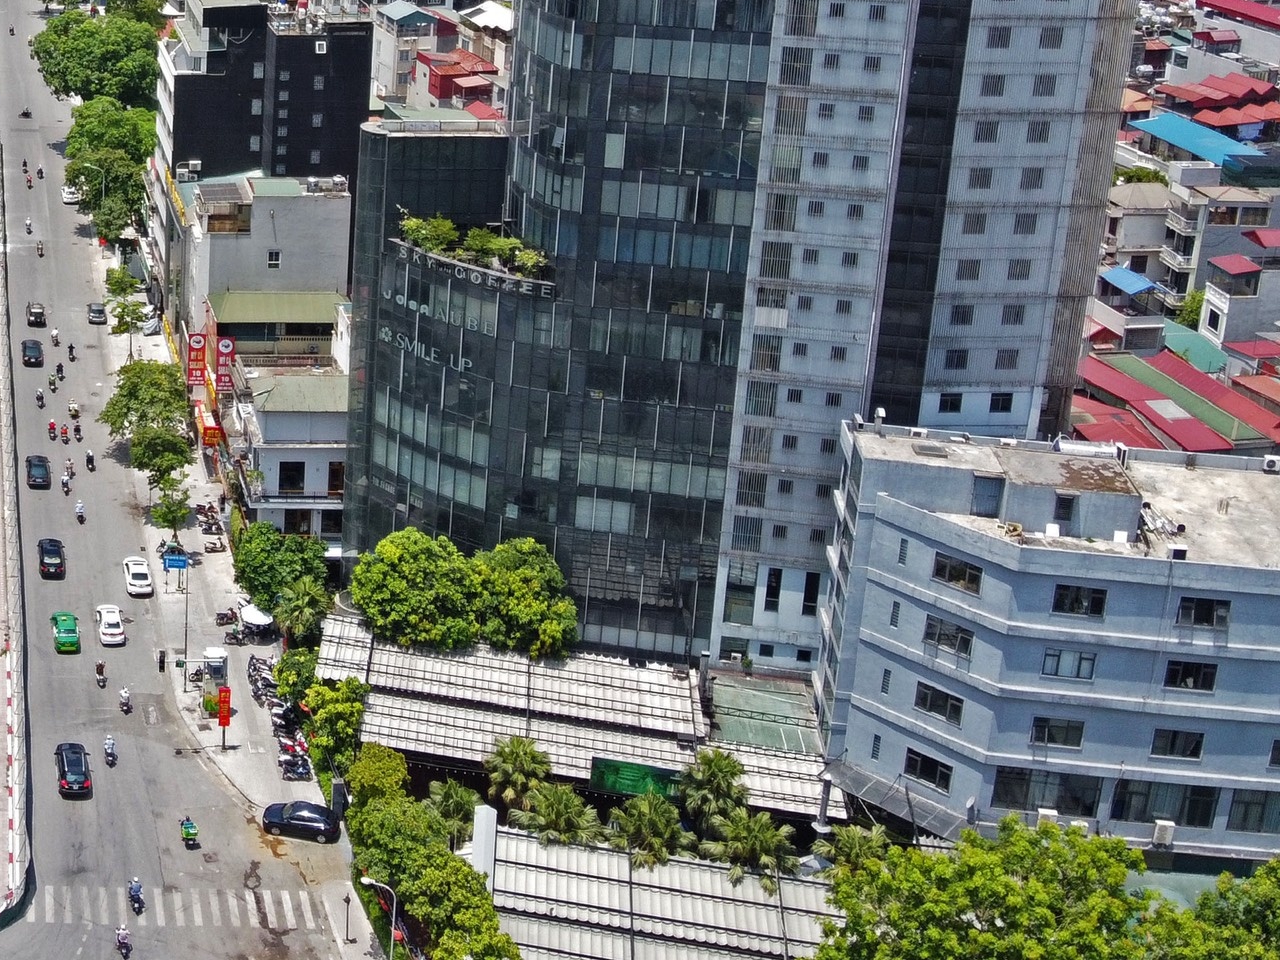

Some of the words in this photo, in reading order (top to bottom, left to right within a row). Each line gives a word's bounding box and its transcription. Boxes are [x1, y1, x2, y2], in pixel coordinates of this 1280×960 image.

[399, 246, 434, 269] SKY
[454, 266, 552, 298] COFFEE
[435, 308, 495, 337] AUBE
[395, 332, 441, 365] SMILE
[450, 353, 473, 372] UP
